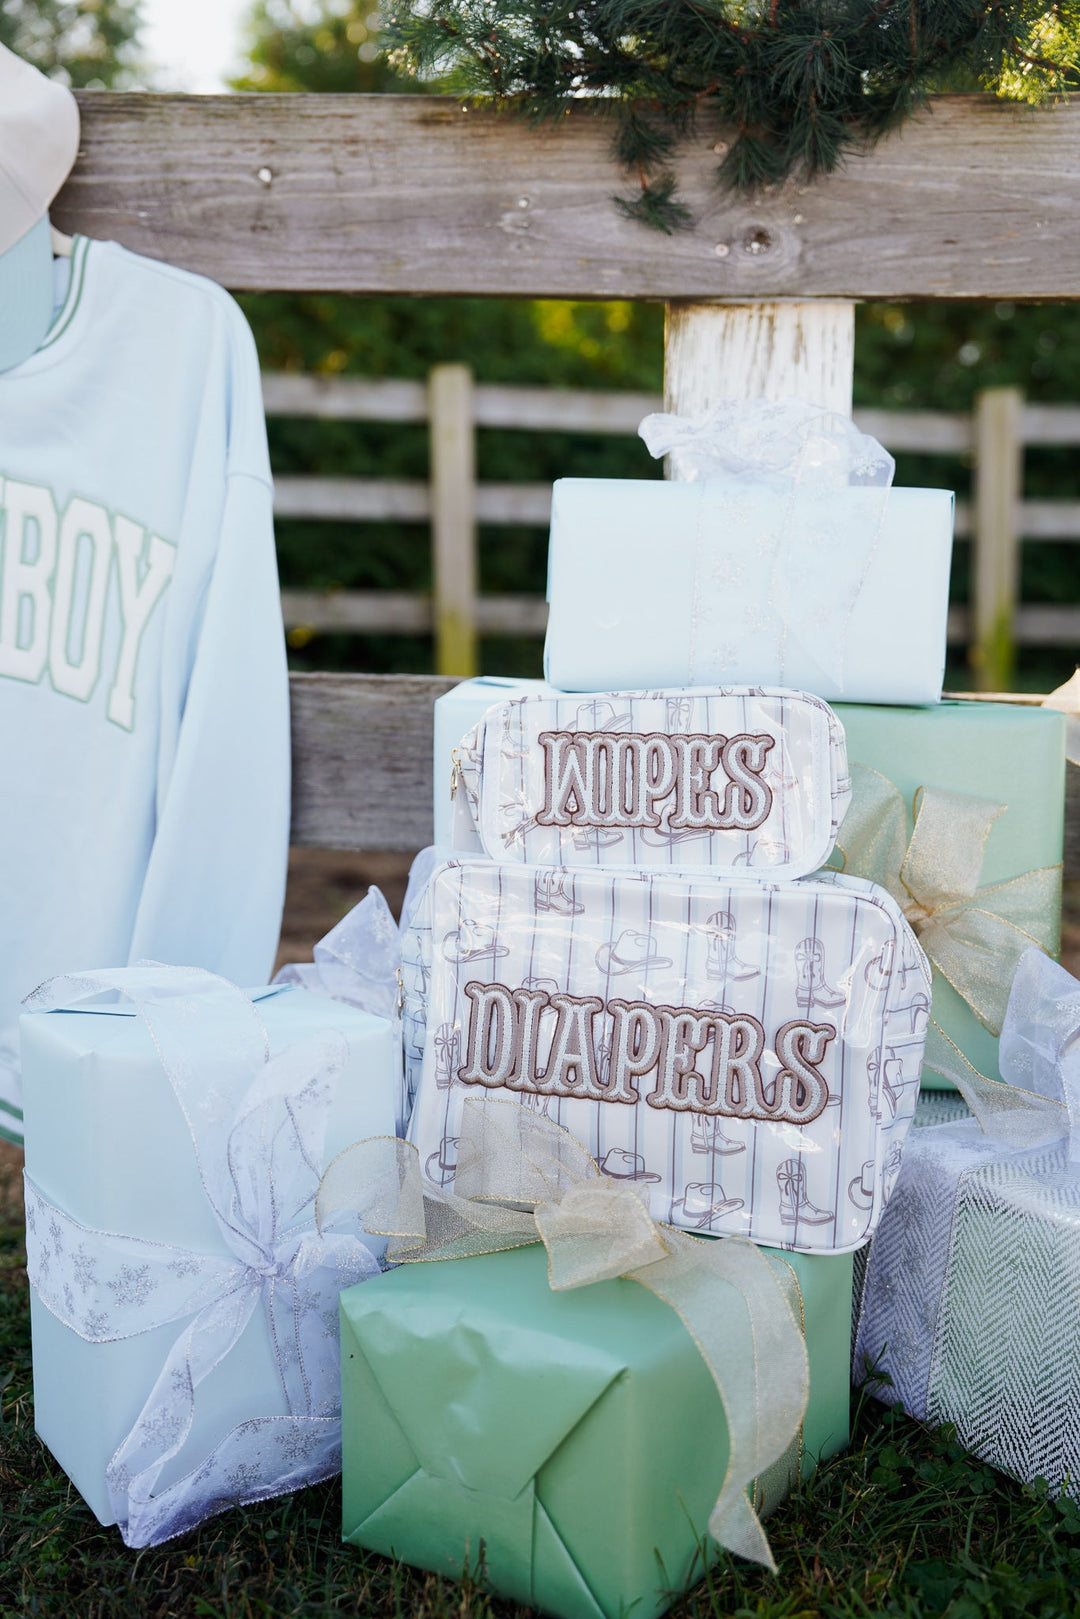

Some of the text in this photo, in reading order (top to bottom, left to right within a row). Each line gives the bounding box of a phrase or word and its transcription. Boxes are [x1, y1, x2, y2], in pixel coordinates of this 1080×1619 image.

[0, 472, 178, 734] BOY
[536, 731, 775, 830] WIPES
[457, 981, 836, 1124] DIAPERS
